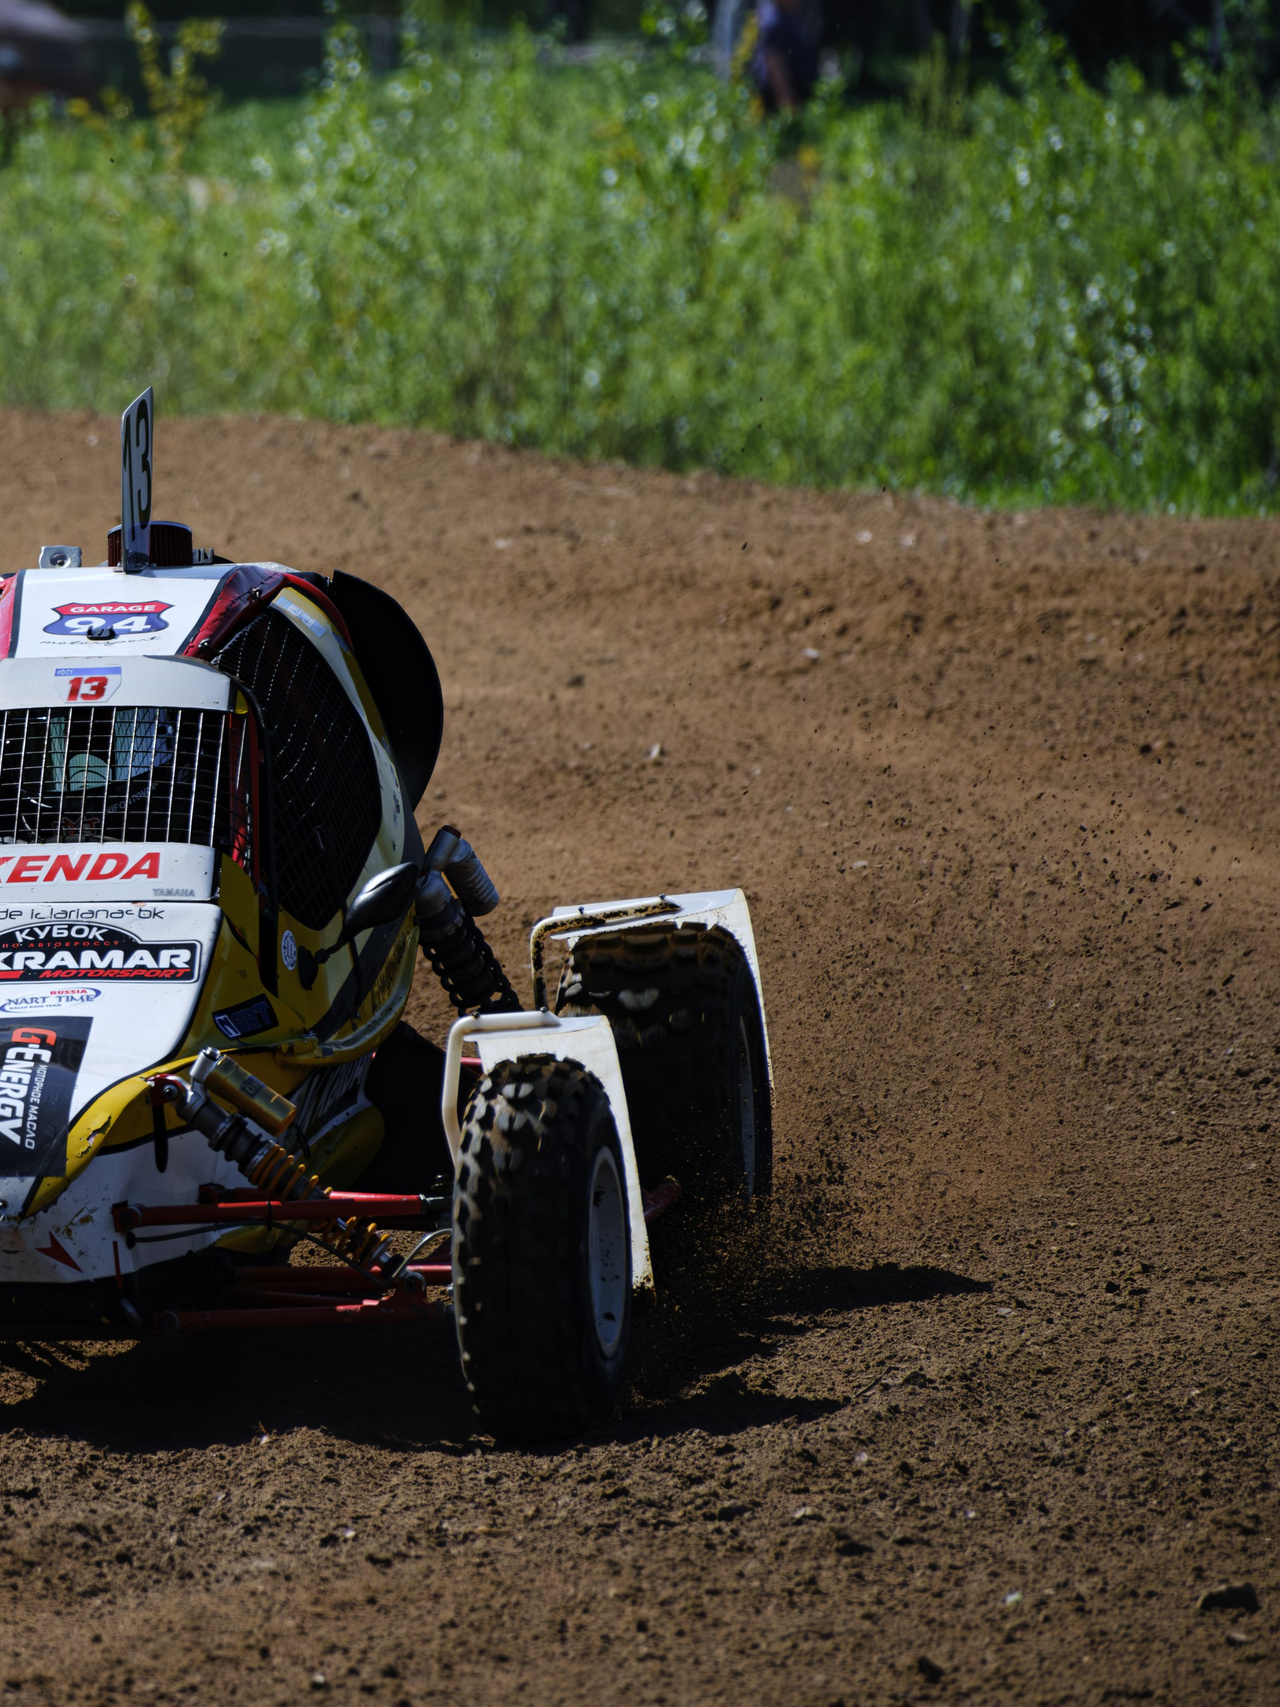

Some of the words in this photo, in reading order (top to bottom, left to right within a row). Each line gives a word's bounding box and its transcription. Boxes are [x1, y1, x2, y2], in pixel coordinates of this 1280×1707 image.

[123, 399, 152, 542] 13
[70, 604, 156, 613] GARAGE
[64, 615, 151, 633] 94
[66, 676, 109, 702] 13
[152, 888, 196, 897] YAMAHA
[15, 924, 109, 942] КУБОК
[28, 940, 120, 948] АВТОКРОССУ
[39, 968, 191, 979] MOTORSPORT
[7, 997, 49, 1005] NART
[56, 995, 95, 1003] TIME
[214, 999, 272, 1039] NART
[29, 1064, 49, 1105] МОТОРНОЕ
[25, 1104, 40, 1149] МАСЛО
